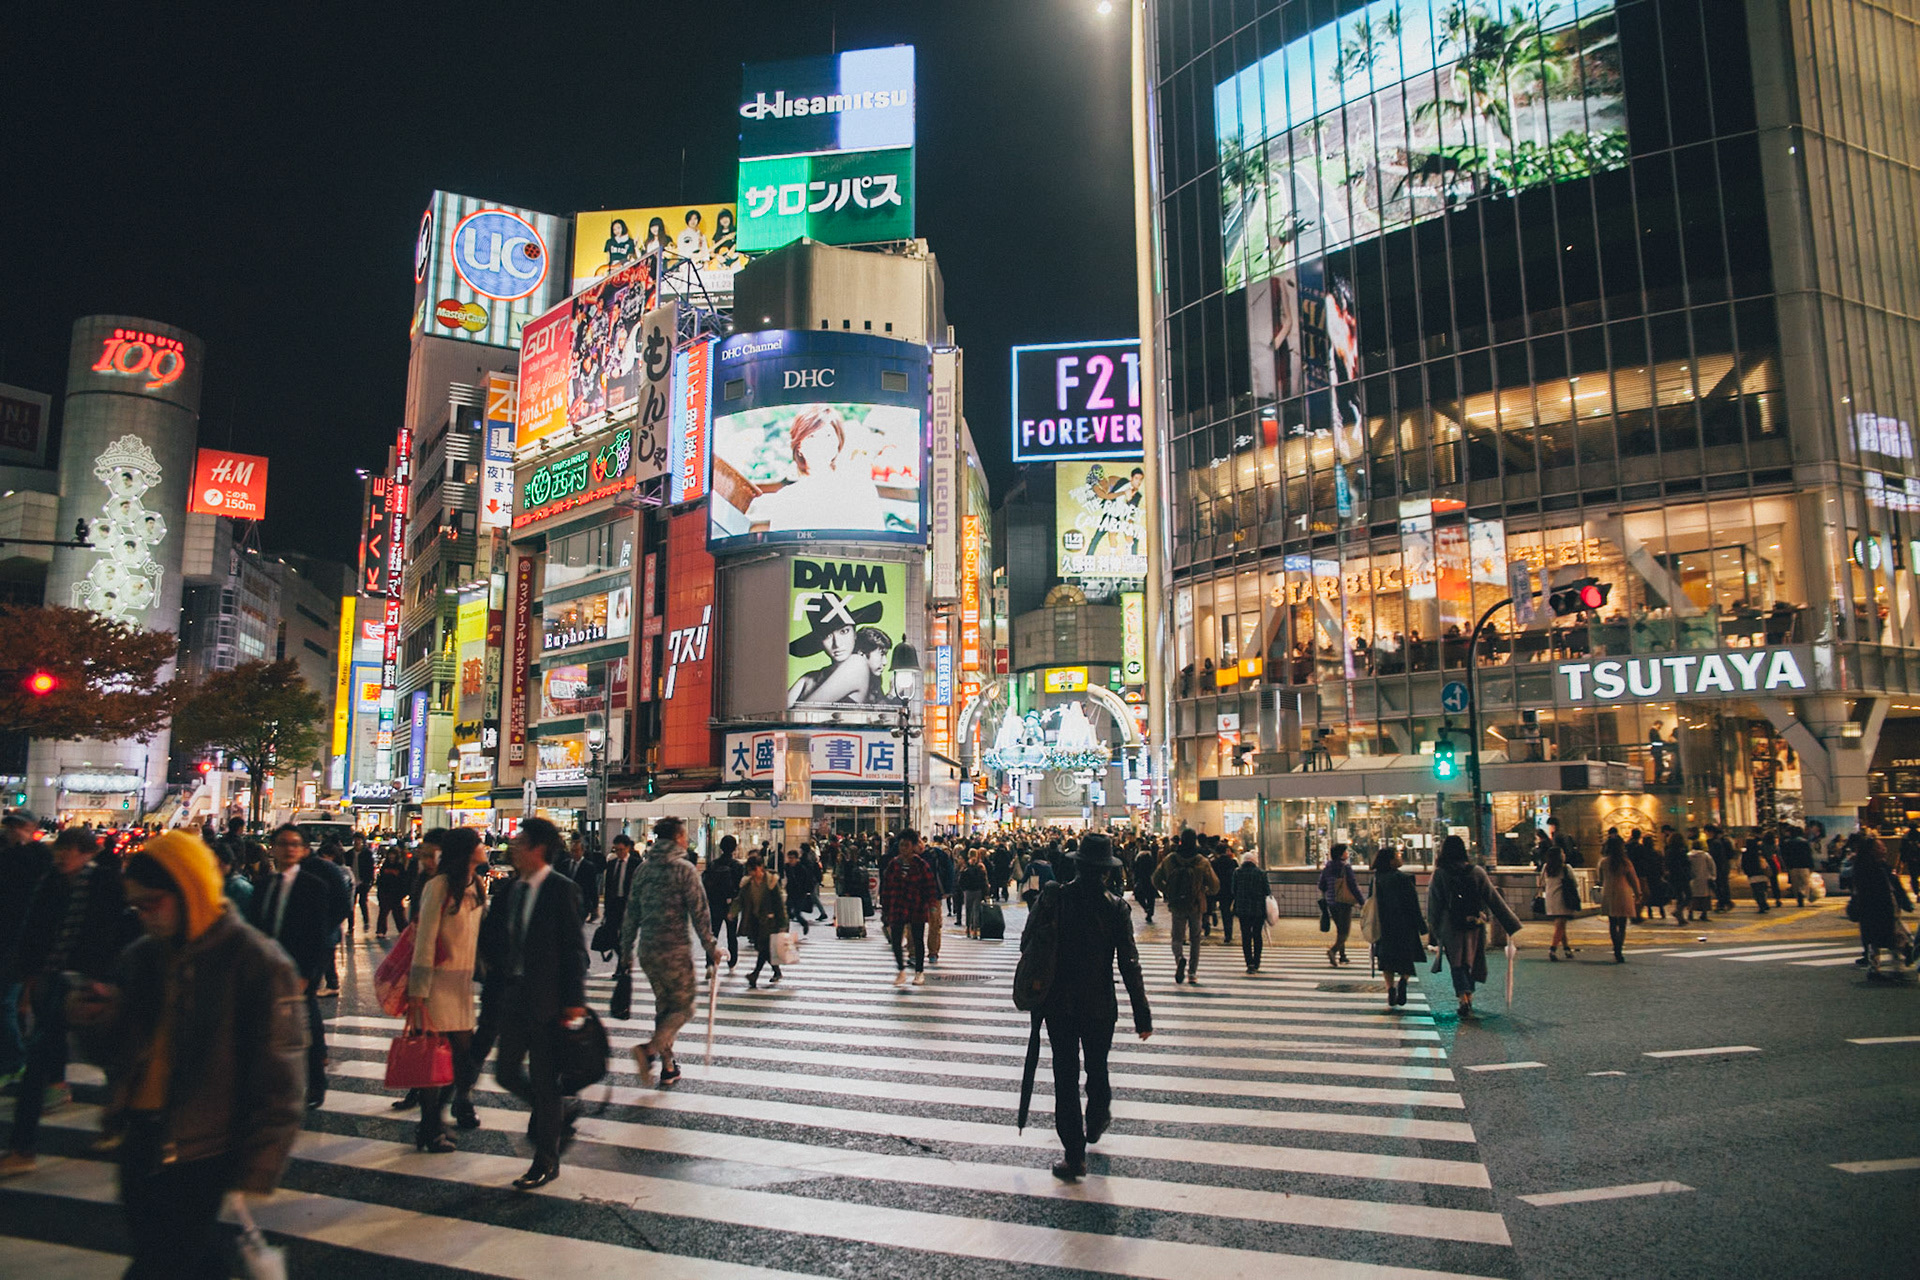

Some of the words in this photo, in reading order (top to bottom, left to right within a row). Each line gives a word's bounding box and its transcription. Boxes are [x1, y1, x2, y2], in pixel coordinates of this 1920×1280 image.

[739, 90, 907, 120] Hisamitsu
[745, 174, 902, 218] サロンパス
[436, 307, 489, 324] MasterCard
[114, 328, 185, 352] SHIBUYA
[522, 314, 570, 363] GOT7
[721, 346, 742, 361] DHC
[742, 339, 783, 356] Channel
[91, 339, 186, 388] 109
[783, 368, 836, 389] DHC
[638, 326, 672, 471] もんじゃ
[1056, 353, 1140, 411] F21
[520, 392, 564, 426] 2016.11.16
[682, 350, 701, 490] 三千里薬品
[936, 379, 952, 459] Taisei
[1022, 414, 1142, 447] FOREVER
[211, 458, 255, 487] H&M
[551, 462, 588, 498] 西村
[225, 499, 256, 512] 150m
[936, 467, 948, 534] neon
[367, 477, 386, 591] KATE
[384, 474, 395, 512] TOKYO
[797, 531, 816, 540] DHC
[793, 560, 888, 594] DMM
[792, 592, 856, 625] FX
[544, 624, 605, 650] Euphoria
[664, 604, 713, 700] クスリ
[1558, 650, 1807, 701] TSUTAYA
[732, 738, 895, 772] 大盛書店
